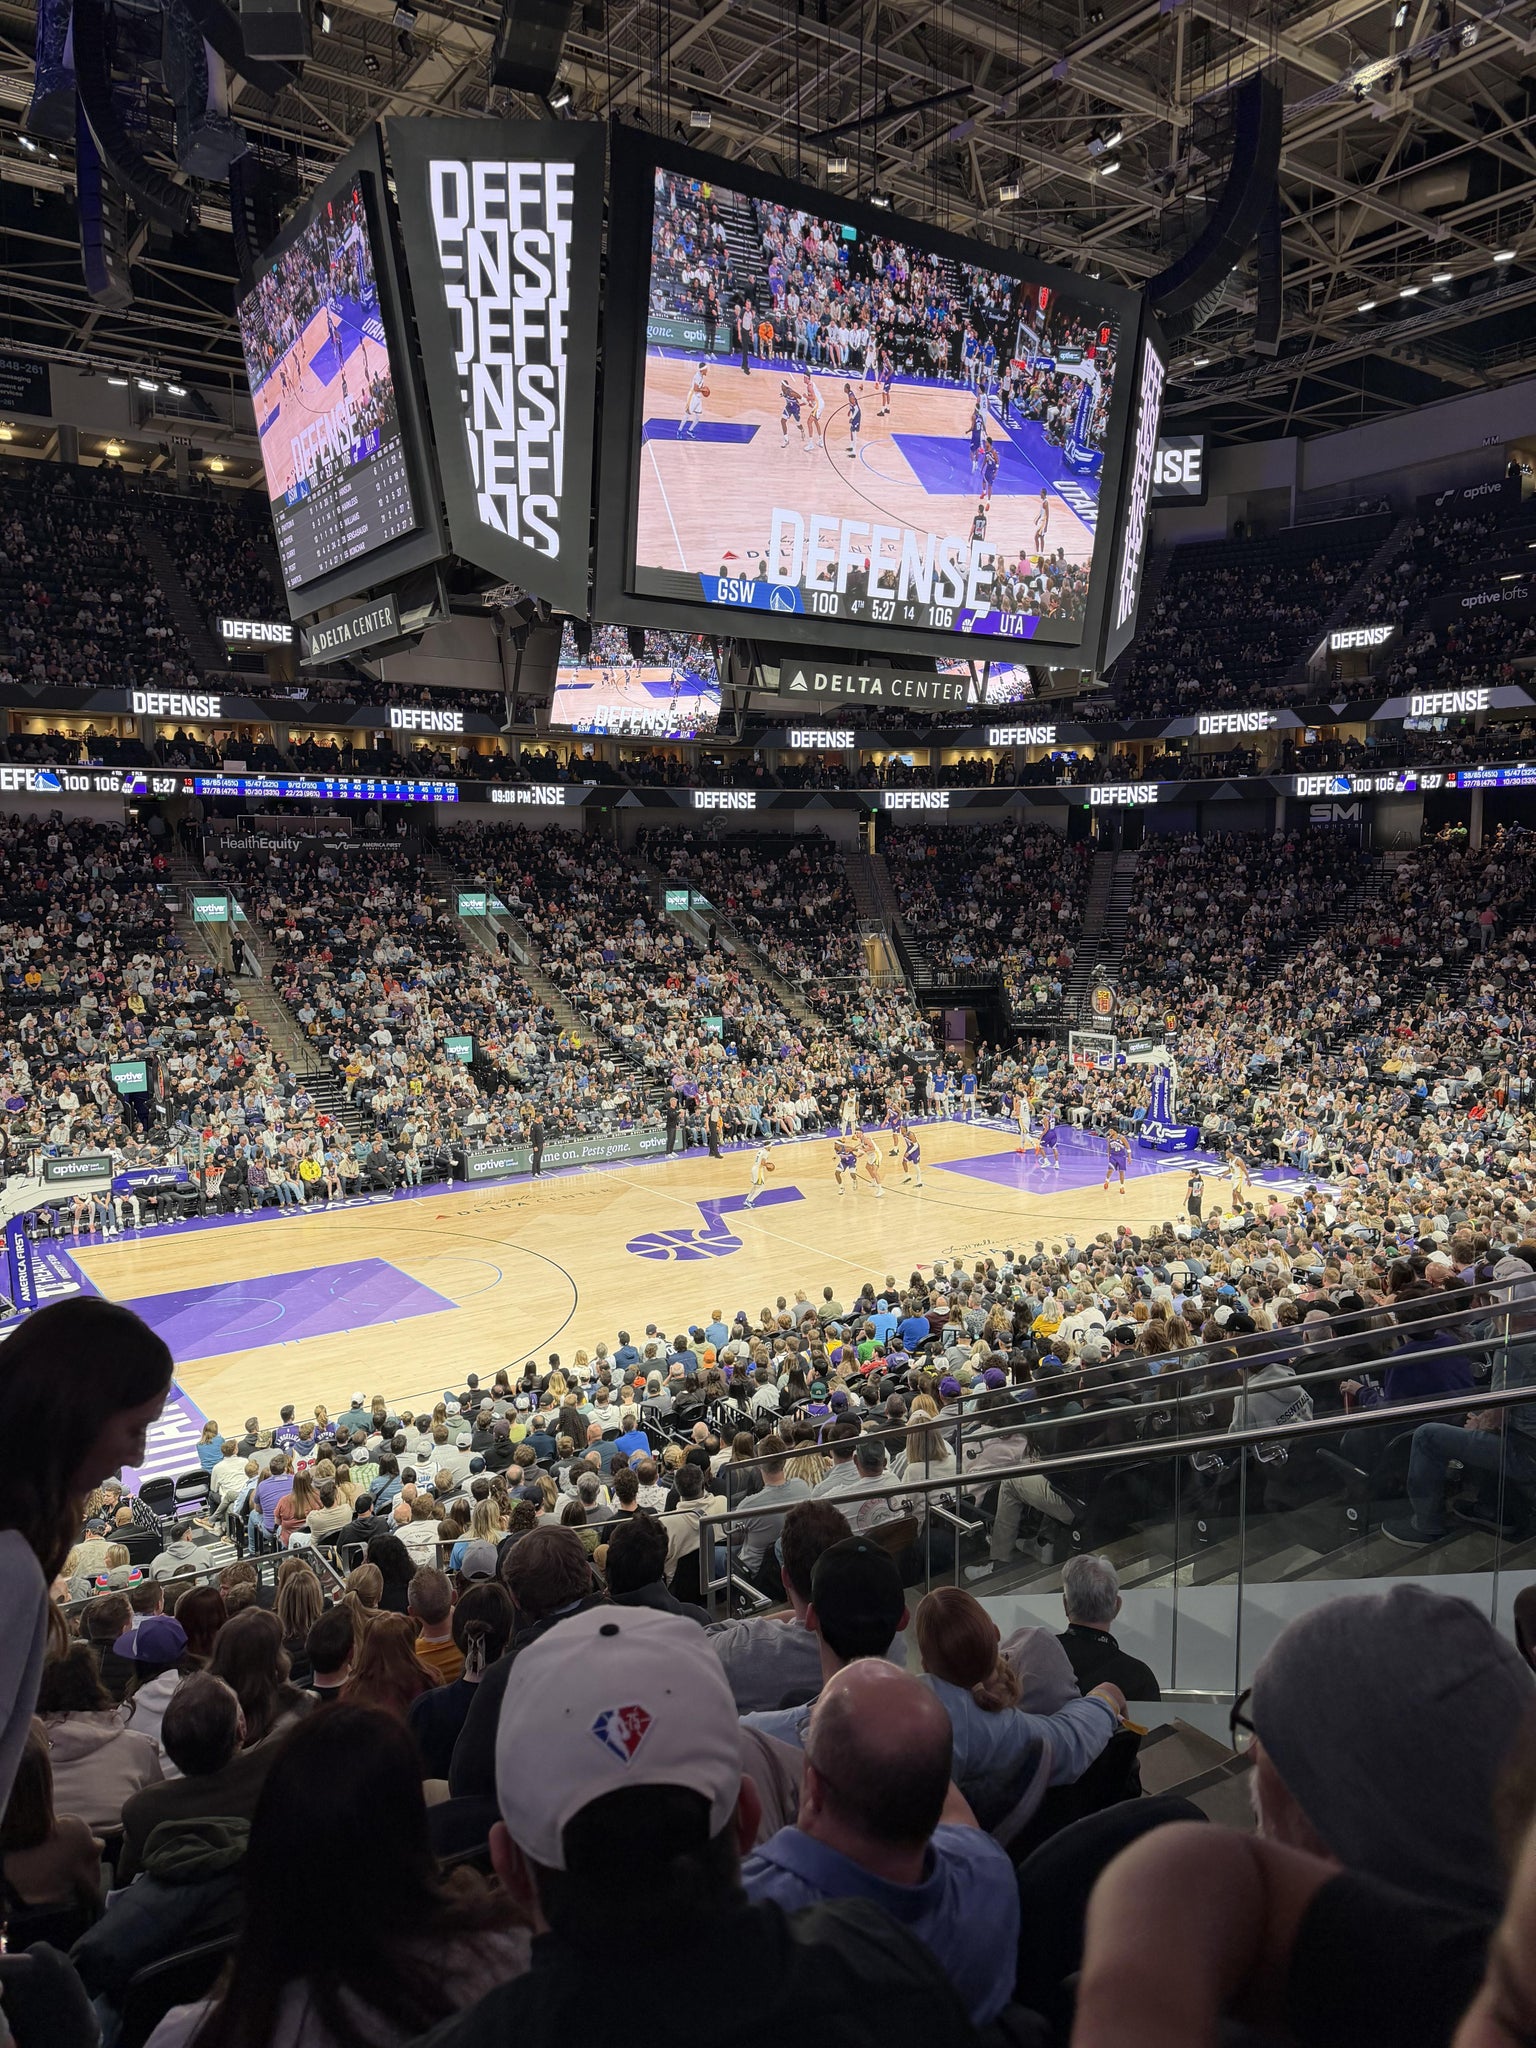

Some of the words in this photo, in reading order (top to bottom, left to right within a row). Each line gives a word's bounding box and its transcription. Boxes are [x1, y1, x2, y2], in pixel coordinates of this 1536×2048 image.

[290, 397, 362, 485] DEFENSE
[1464, 482, 1502, 500] aptive
[768, 507, 997, 611] DEFENSE
[717, 578, 756, 604] GSW
[1461, 592, 1500, 610] aptive
[1502, 585, 1529, 600] lofts
[811, 590, 839, 615] 100
[872, 600, 896, 622] 5:27
[904, 606, 915, 621] 14
[928, 606, 952, 628] 106
[222, 620, 293, 643] DEFENSE
[320, 627, 352, 652] DELTA
[353, 607, 393, 638] CENTER
[1000, 612, 1024, 635] UTA
[1331, 626, 1395, 650] DEFENSE
[814, 673, 884, 696] DELTA
[890, 679, 964, 701] CENTER
[132, 692, 221, 718] DEFENSE
[1411, 688, 1489, 716] DEFENSE
[390, 708, 464, 732] DEFENSE
[594, 704, 680, 732] DEFENSE
[1199, 712, 1268, 734] DEFENSE
[791, 731, 855, 748] DEFENSE
[989, 726, 1056, 746] DEFENSE
[63, 776, 90, 792] 100
[94, 776, 120, 792] 106
[152, 778, 177, 793] 5:27
[1090, 786, 1158, 804] DEFENSE
[1352, 778, 1372, 793] 100
[1376, 777, 1394, 792] 106
[1420, 774, 1442, 789] 5:27
[492, 789, 515, 804] 09:08
[516, 790, 531, 804] PM
[694, 791, 756, 810] DEFENSE
[884, 791, 950, 810] DEFENSE
[220, 838, 300, 852] HealthEquity
[196, 903, 224, 914] aptive
[114, 1072, 144, 1083] aptive
[52, 1162, 90, 1176] aptive
[474, 1158, 505, 1173] aptive
[563, 1151, 580, 1161] on.
[582, 1145, 606, 1158] Pests
[606, 1143, 631, 1157] gone.
[303, 1194, 394, 1212] PACS
[14, 1232, 24, 1260] FIRST
[18, 1260, 30, 1302] AMERICA
